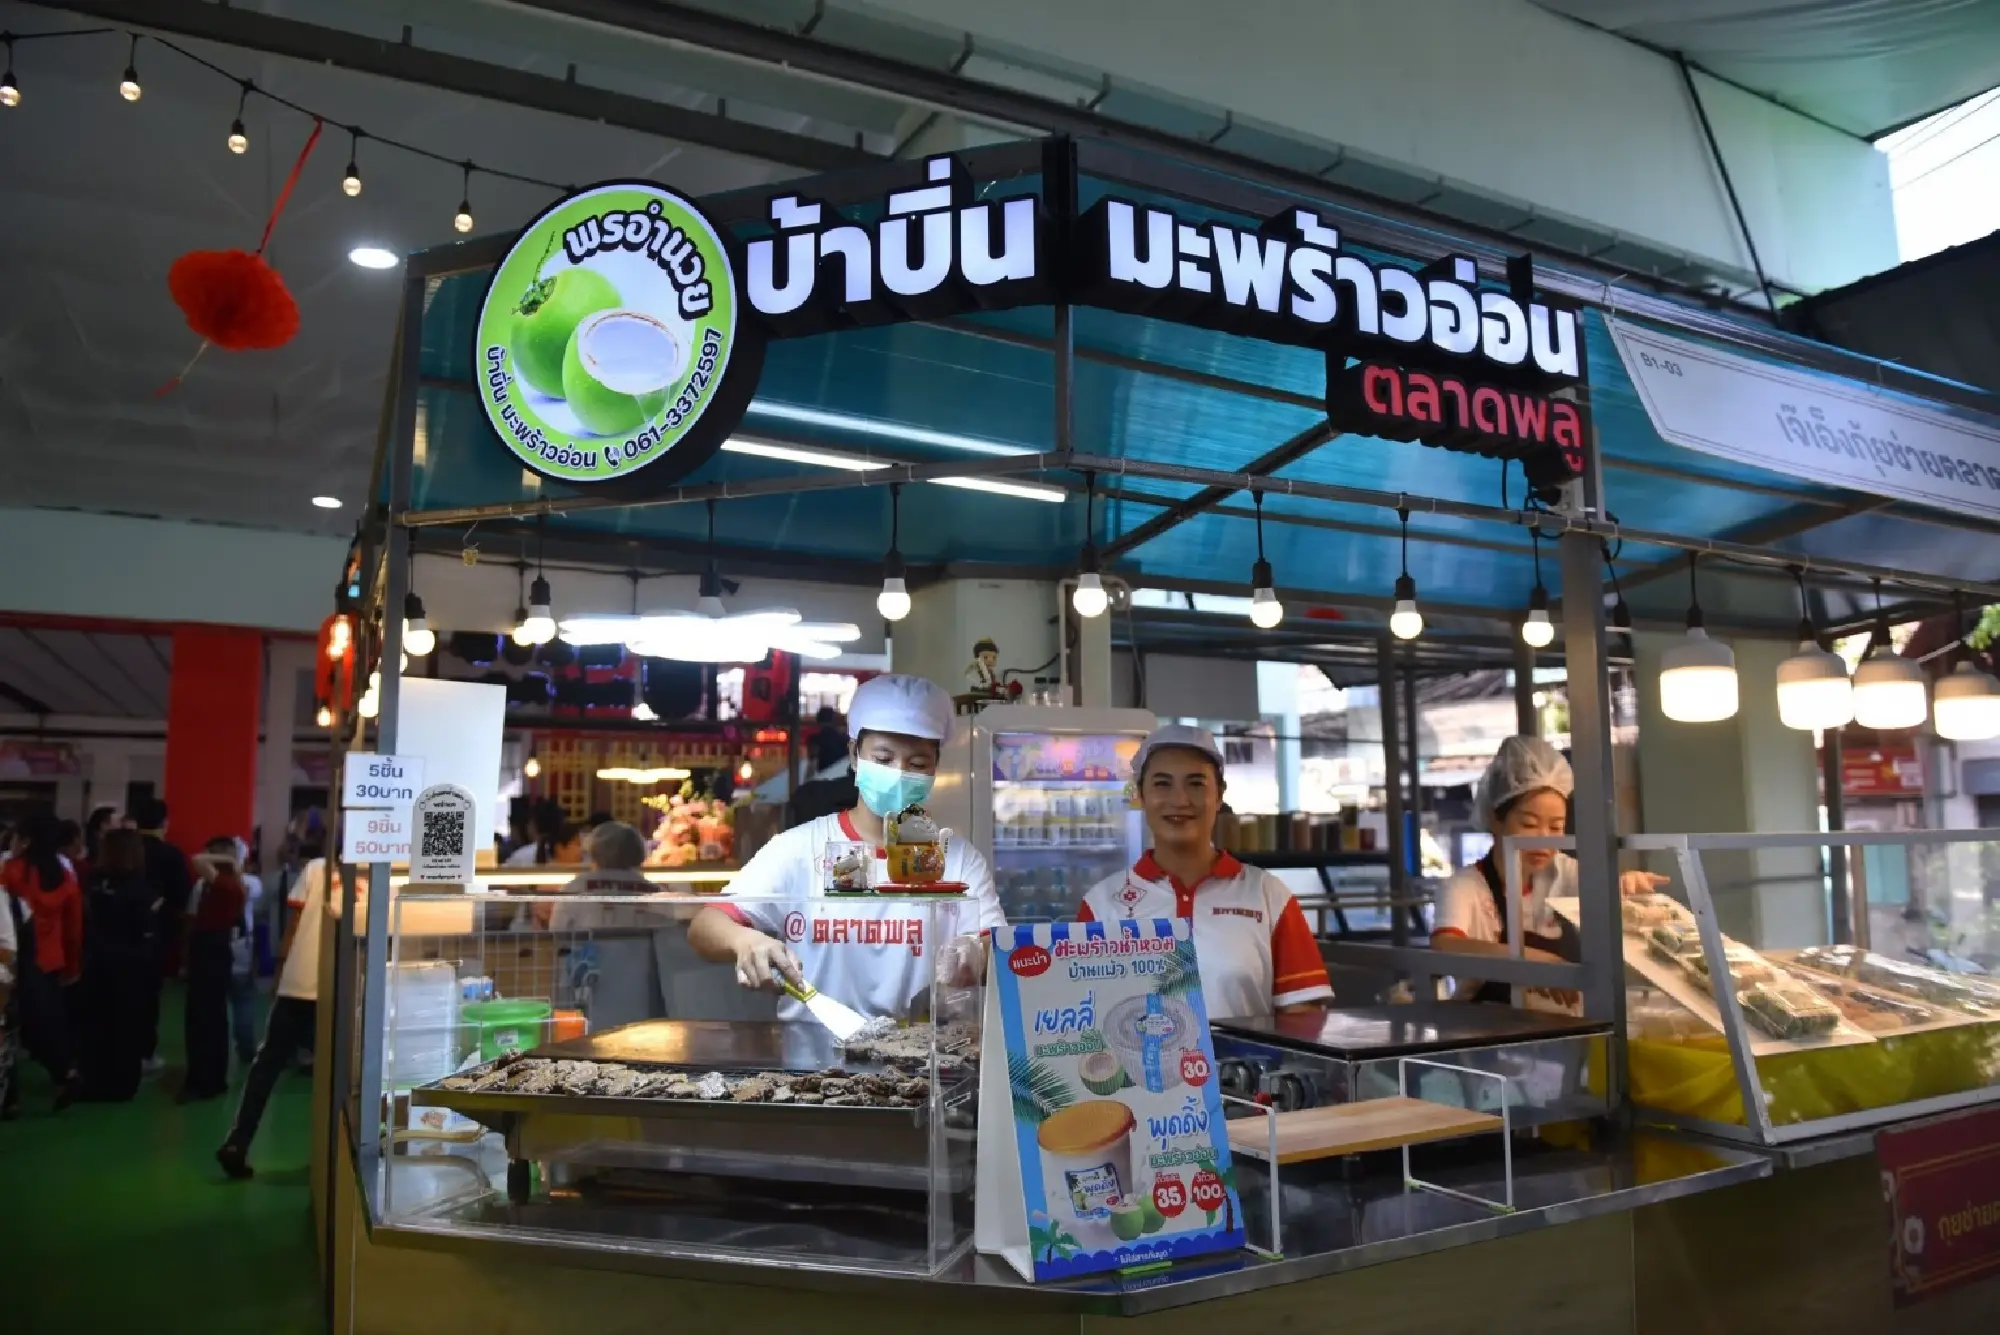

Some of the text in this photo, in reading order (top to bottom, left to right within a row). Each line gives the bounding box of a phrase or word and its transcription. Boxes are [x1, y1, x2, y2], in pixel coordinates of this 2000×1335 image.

[747, 157, 1035, 314] บ้าบิ่น
[563, 199, 713, 320] พรอำนวย
[1107, 200, 1579, 377] มะพร้าวอ่อน
[501, 403, 598, 469] มะพร้าวอ่อน
[624, 328, 722, 459] 061-3372597
[1364, 365, 1583, 471] ตลาดพลู
[356, 785, 412, 799] 30บาท
[355, 841, 412, 855] 50บาท
[784, 911, 923, 957] @ ตลาดพลู
[1055, 926, 1176, 959] มะพร้าวน้ำหอม
[1012, 953, 1047, 969] แนะนำ
[1131, 958, 1166, 975] 100%
